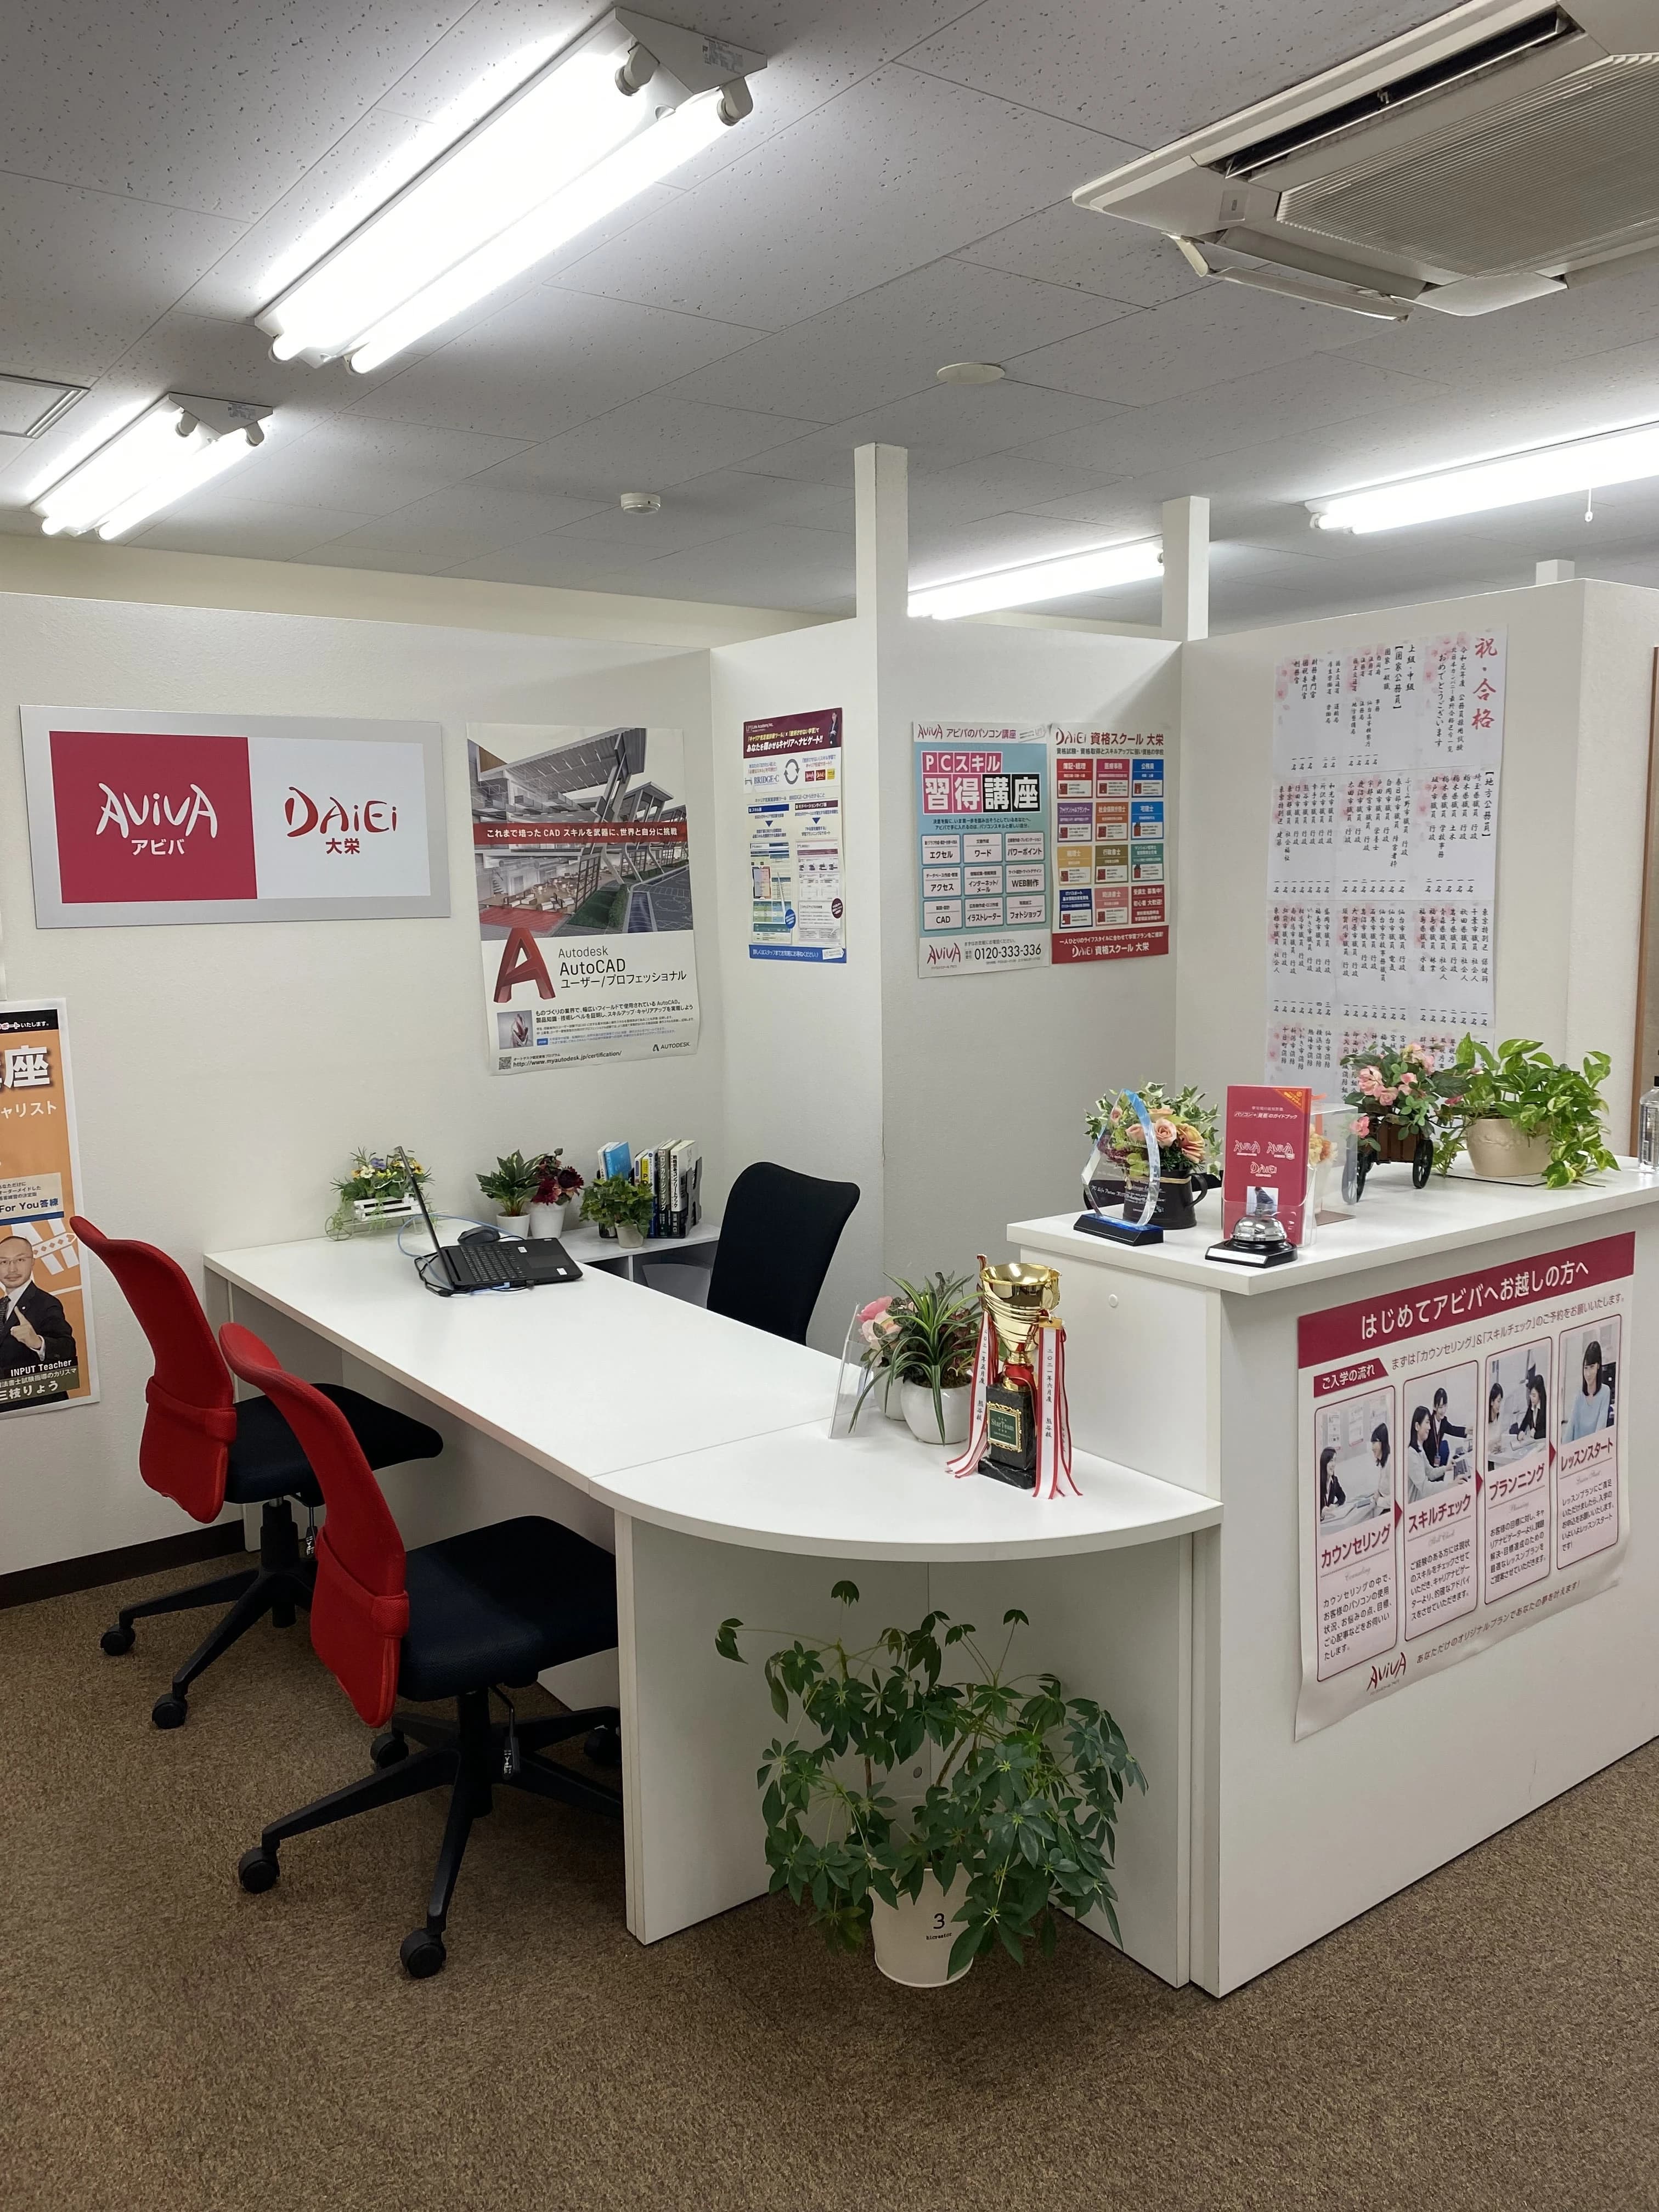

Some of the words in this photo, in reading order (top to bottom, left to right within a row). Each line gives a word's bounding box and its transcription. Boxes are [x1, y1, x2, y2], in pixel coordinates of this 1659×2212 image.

[1393, 646, 1403, 708] 【国家公務員】
[1406, 645, 1415, 691] 上級・中級
[1472, 639, 1497, 730] 祝・合格
[1435, 653, 1446, 747] おめでとうございます
[946, 729, 1016, 738] アビバのパソコン講座
[1091, 732, 1143, 746] 資格スクール
[1147, 733, 1164, 746] 大栄
[926, 754, 1000, 771] PCスキル
[925, 777, 1038, 810] 習得講座
[1482, 772, 1494, 836] 【地方公務員】
[487, 829, 541, 838] これまで培った
[563, 827, 678, 837] スキルを武器に、世界と自分に挑戦
[1449, 825, 1456, 840] 土木
[131, 839, 185, 856] アビバ
[325, 838, 360, 855] 大栄
[930, 850, 953, 859] エクセル
[1008, 848, 1042, 856] パワーポイント
[930, 883, 954, 891] アクセス
[967, 913, 1001, 922] イラストレーター
[1010, 910, 1041, 919] フォトショップ
[558, 945, 608, 958] Autodesk
[975, 944, 1041, 960] 0120-333-336
[1096, 945, 1133, 955] 資格スクール
[1136, 943, 1149, 951] 大栄
[560, 958, 626, 976] AutoCAD
[561, 970, 687, 989] ユーザー/プロフェッショナル
[0, 1022, 49, 1030] ポートいたします。
[0, 1045, 50, 1088] 座
[1361, 1260, 1589, 1340] はじめてアビバへお越しの方へ
[11, 1365, 36, 1376] INPUT
[38, 1360, 72, 1372] Teacher
[1322, 1363, 1375, 1390] ご入学の流れ
[1561, 1437, 1613, 1472] レッスンスタート
[1489, 1463, 1544, 1500] プランニング
[1409, 1494, 1471, 1533] スキルチェック
[1322, 1525, 1391, 1568] カウンセリング
[1410, 1539, 1470, 1571] ご経験のある方には現状
[1410, 1551, 1470, 1583] のスキルをチェックさせて
[1323, 1573, 1391, 1607] カウンセリングの中で、
[1324, 1586, 1390, 1621] お客様のパソコンの使用
[1412, 1590, 1469, 1621] スをさせていただきます。
[1324, 1599, 1392, 1634] 状況、お悩みの点、目標、
[1324, 1645, 1350, 1661] たします。
[933, 1913, 945, 1929] 3
